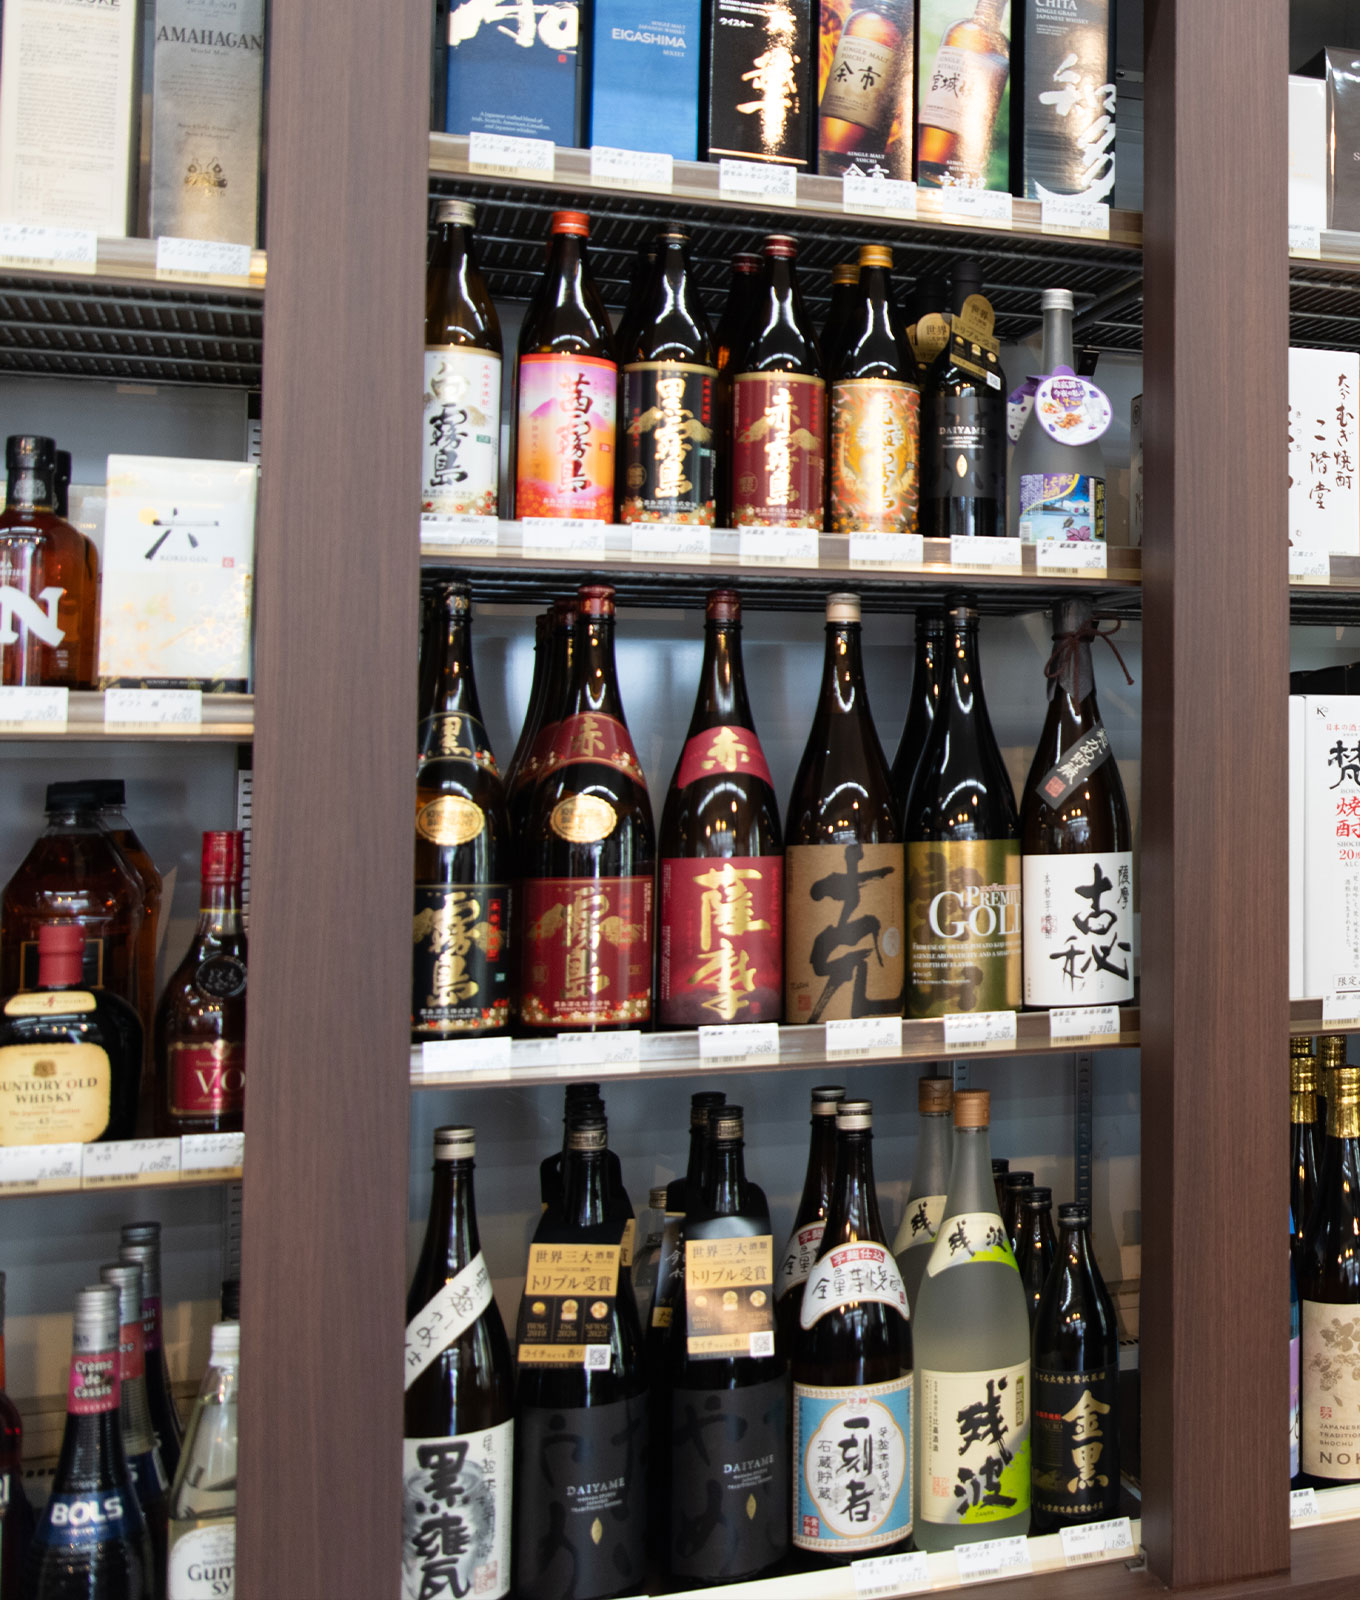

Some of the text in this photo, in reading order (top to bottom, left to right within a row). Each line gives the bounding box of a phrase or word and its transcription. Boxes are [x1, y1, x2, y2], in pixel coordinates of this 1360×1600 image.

[719, 17, 754, 28] ウイスキー
[157, 25, 264, 50] AMAHAGAN
[611, 27, 687, 49] EIGASHIMA
[833, 61, 882, 91] 余市
[926, 324, 947, 336] 世界
[938, 426, 987, 436] DAIYAME
[1309, 419, 1332, 510] 二階堂
[440, 715, 472, 757] 黒
[570, 715, 606, 758] 赤
[700, 726, 752, 772] 赤
[1049, 862, 1133, 994] 古秘
[66, 1077, 97, 1089] OLD
[15, 1092, 73, 1104] WHISKY
[947, 1219, 1009, 1258] 残波
[531, 1273, 612, 1293] トリプル受賞
[692, 1265, 768, 1285] トリプル受賞
[75, 1359, 113, 1373] Crème
[74, 1384, 112, 1398] Cassis
[84, 1373, 101, 1386] de
[953, 1374, 1018, 1517] 残波
[1061, 1389, 1111, 1495] 金黒
[723, 1454, 775, 1475] DAIYAME
[817, 1439, 833, 1501] 石蔵貯蔵
[835, 1416, 876, 1523] 一刻者
[566, 1477, 626, 1497] DAIYAME
[51, 1496, 123, 1525] BOLS
